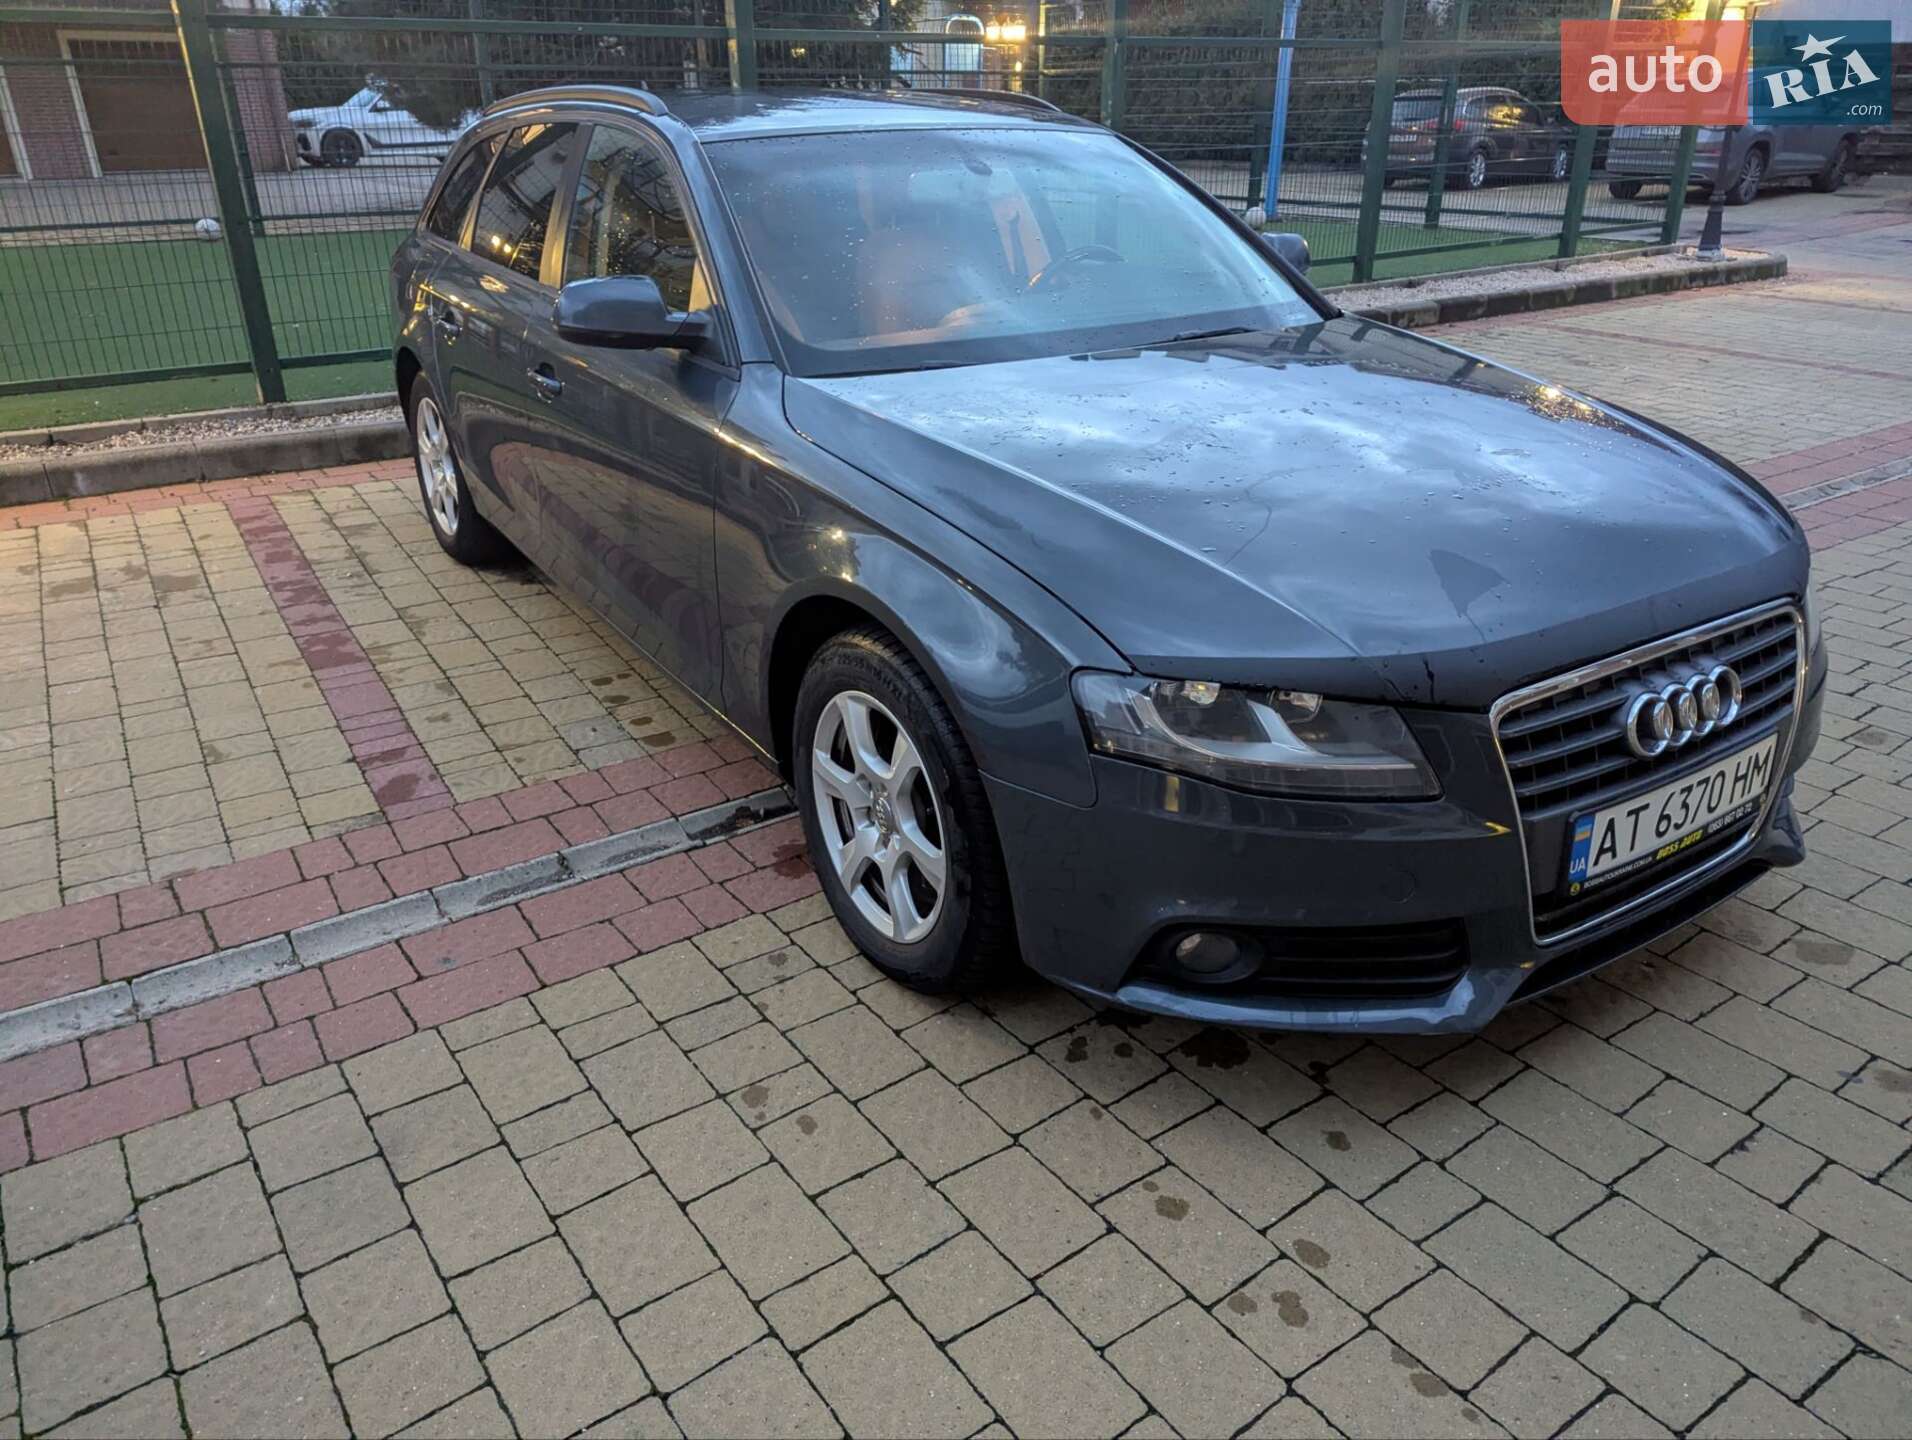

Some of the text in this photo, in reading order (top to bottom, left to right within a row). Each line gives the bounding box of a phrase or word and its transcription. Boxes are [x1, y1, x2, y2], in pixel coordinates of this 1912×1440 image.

[1592, 803, 1651, 867] AT
[1655, 769, 1726, 839] 6370
[1729, 745, 1772, 805] HM
[1569, 856, 1586, 874] UA
